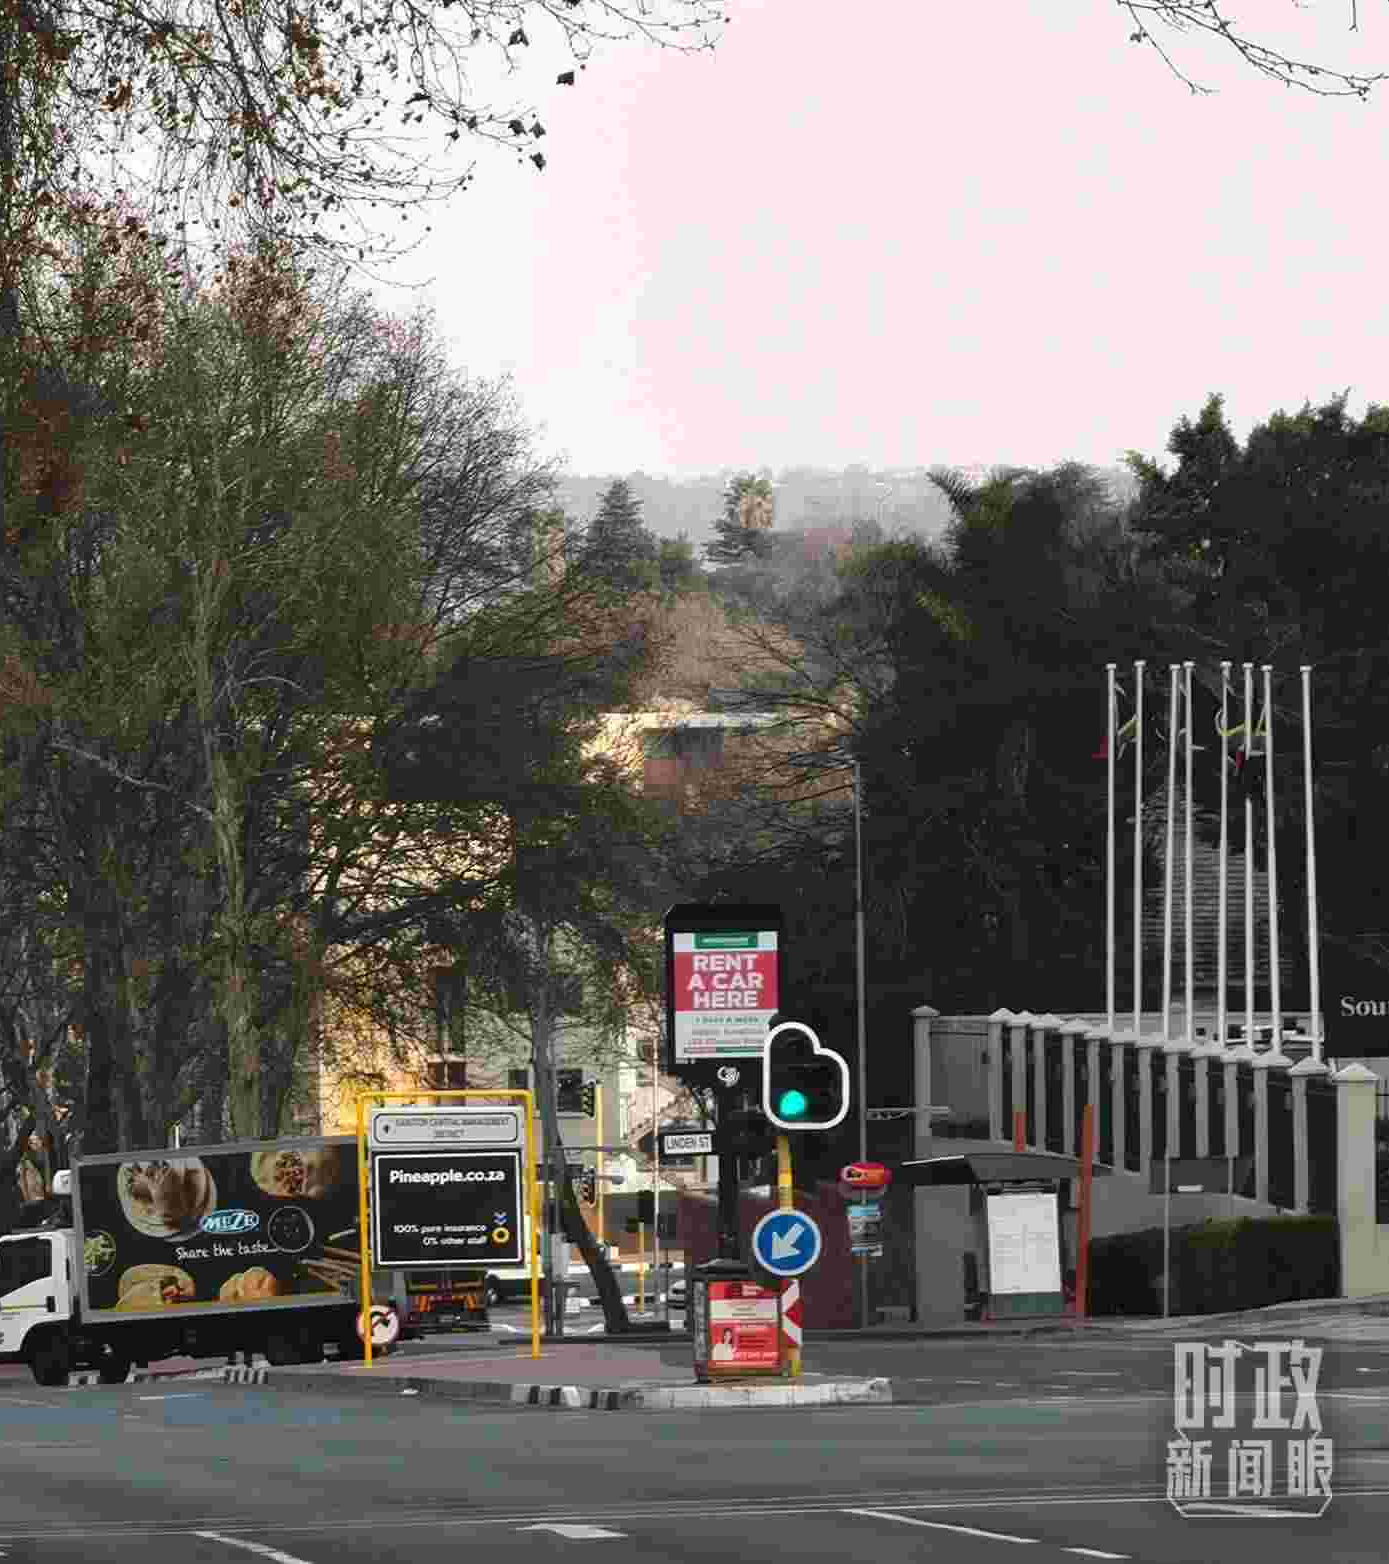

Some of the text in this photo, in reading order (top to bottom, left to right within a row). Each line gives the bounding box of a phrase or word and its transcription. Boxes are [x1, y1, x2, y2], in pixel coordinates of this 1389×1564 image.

[692, 953, 758, 972] RENT
[686, 972, 764, 991] A CAR
[692, 990, 758, 1009] HERE
[389, 1168, 506, 1185] Pineapple.co.za
[393, 1224, 420, 1233] 100%
[422, 1236, 439, 1246] 0%
[174, 1246, 211, 1261] Share
[212, 1241, 235, 1257] the
